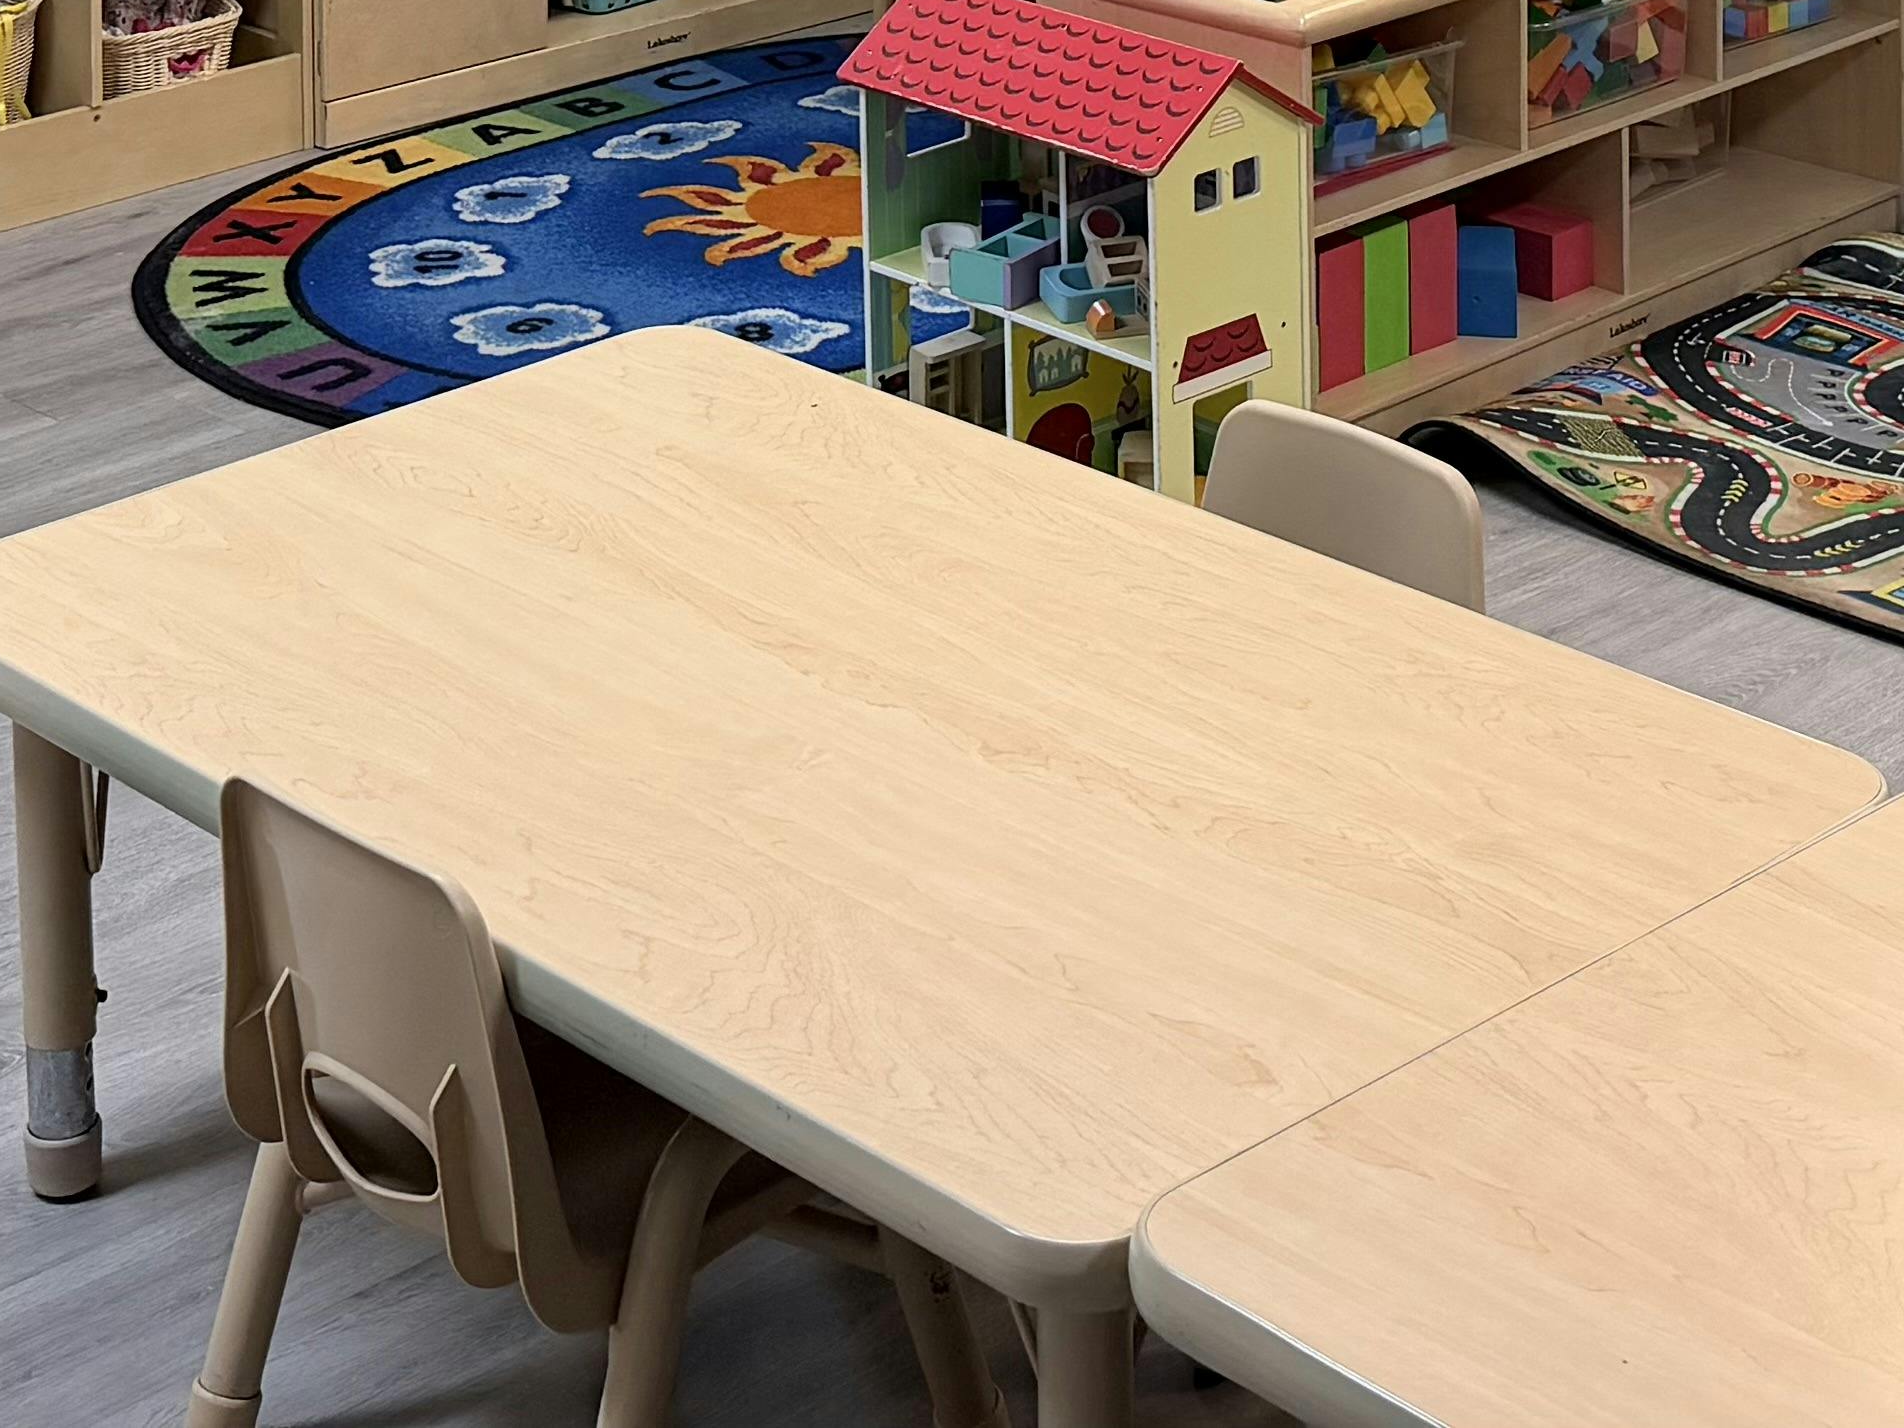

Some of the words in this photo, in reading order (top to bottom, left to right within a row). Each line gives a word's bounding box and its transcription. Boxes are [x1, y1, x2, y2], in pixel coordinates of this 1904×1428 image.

[352, 147, 435, 176] Z
[470, 123, 541, 146] A
[556, 96, 625, 119] B
[652, 69, 722, 92] C
[761, 47, 826, 70] D
[643, 129, 686, 146] 2
[266, 181, 344, 205] Y
[483, 189, 529, 202] 1
[213, 217, 298, 246] X
[412, 248, 466, 277] 10
[191, 268, 271, 310] W
[215, 318, 294, 347] V
[503, 315, 555, 337] 9
[276, 356, 373, 394] U
